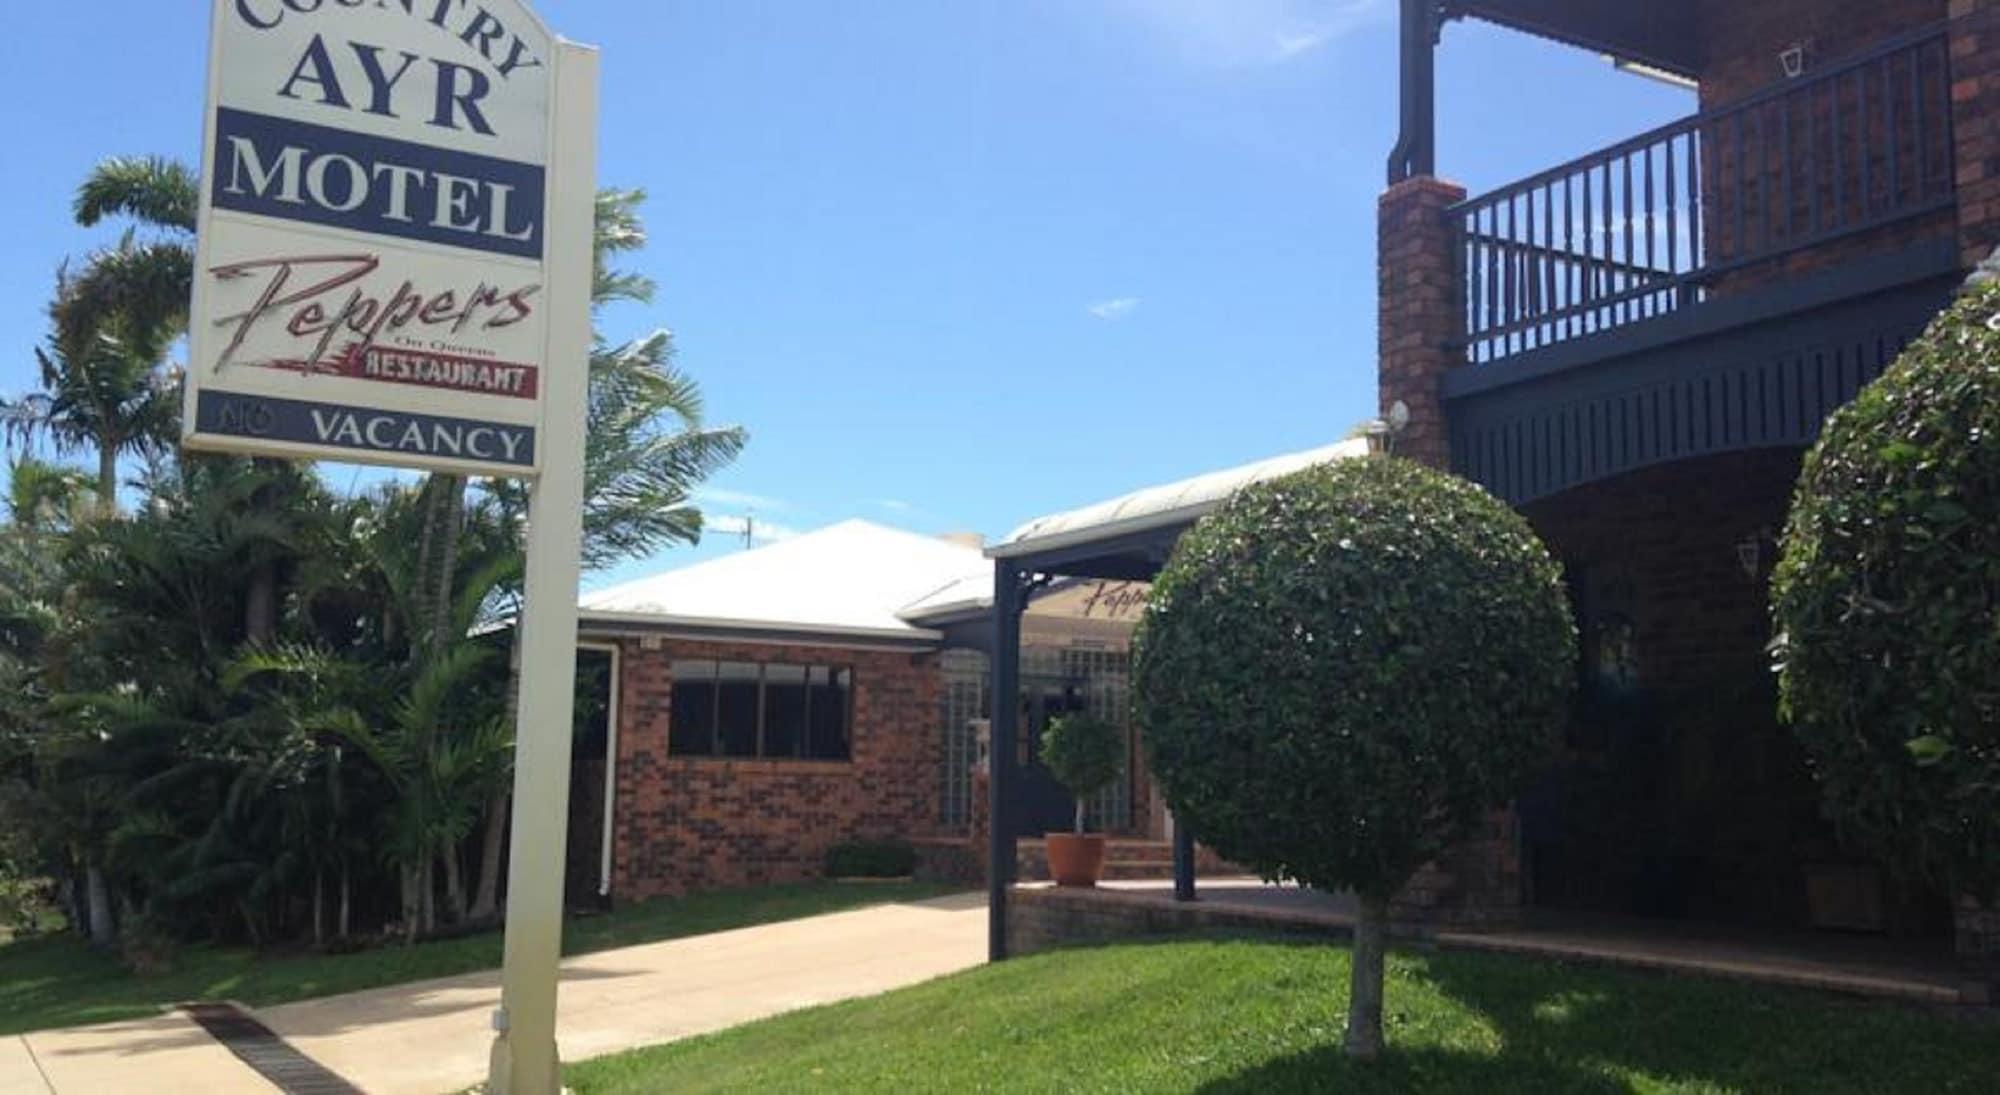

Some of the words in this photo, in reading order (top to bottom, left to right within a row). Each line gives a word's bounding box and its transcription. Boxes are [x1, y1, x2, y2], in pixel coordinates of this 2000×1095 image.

[236, 0, 543, 79] CTRY
[278, 33, 497, 136] AYR
[223, 136, 534, 241] MOTEL
[209, 254, 541, 376] Peppers
[366, 351, 526, 392] RESTAURANT
[311, 409, 525, 460] VACANCY
